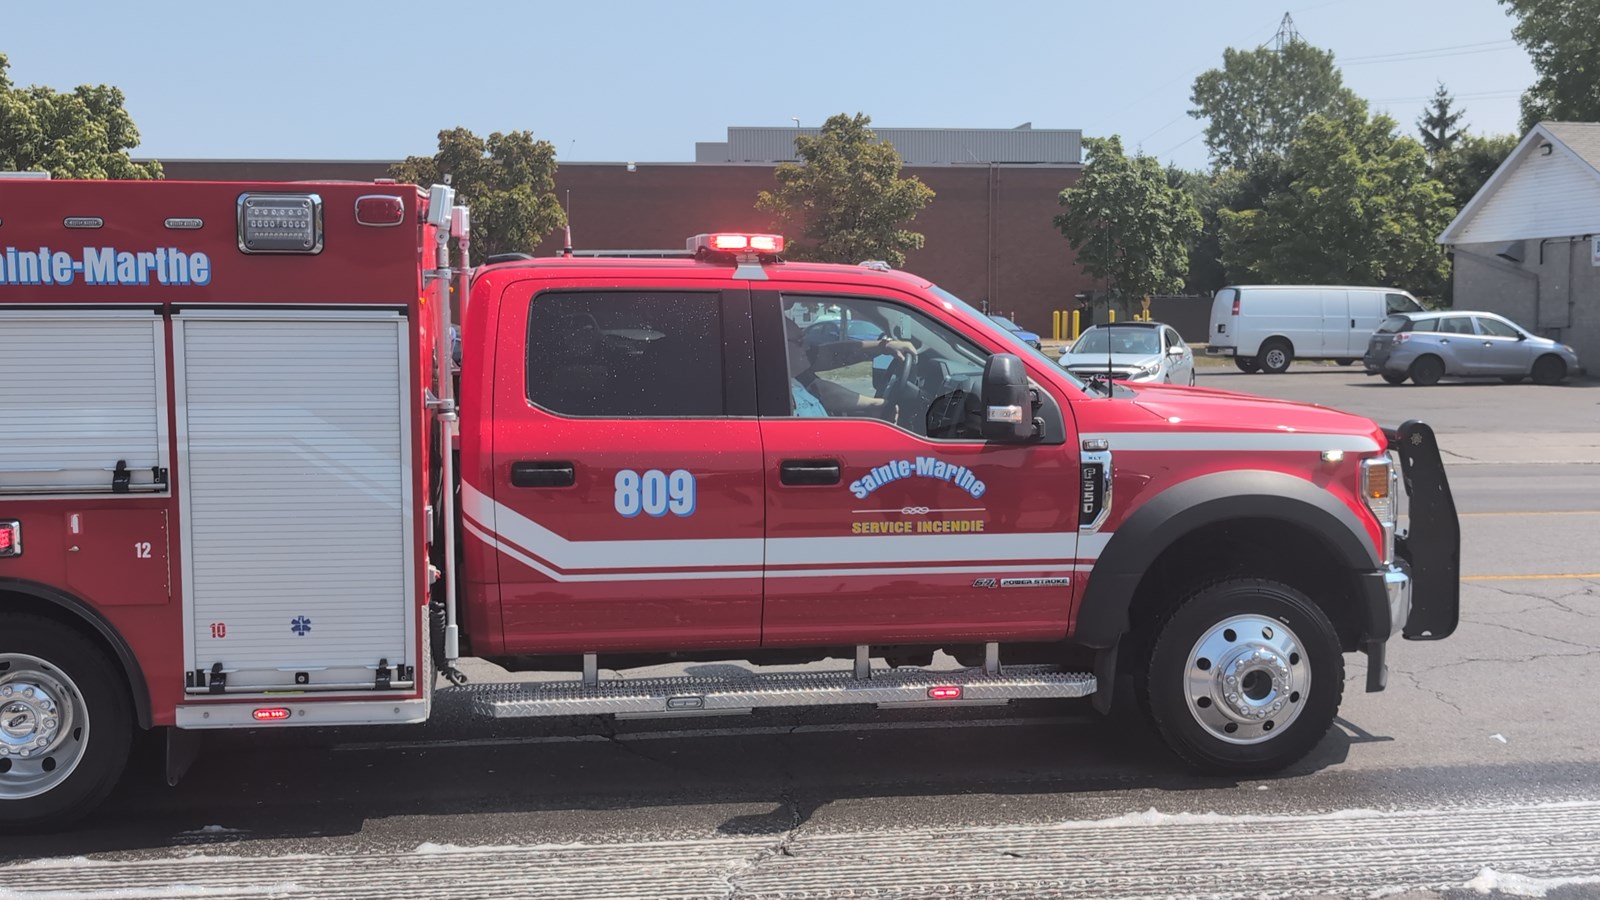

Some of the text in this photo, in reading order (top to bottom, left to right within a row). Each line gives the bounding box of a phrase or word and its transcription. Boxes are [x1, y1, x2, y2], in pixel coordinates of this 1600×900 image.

[0, 246, 211, 285] inte-Marthe
[849, 456, 986, 499] Sainte-Marthe
[614, 469, 697, 518] 809
[851, 520, 984, 533] SERVICE INCENDIE
[134, 542, 152, 559] 12
[209, 622, 226, 639] 10
